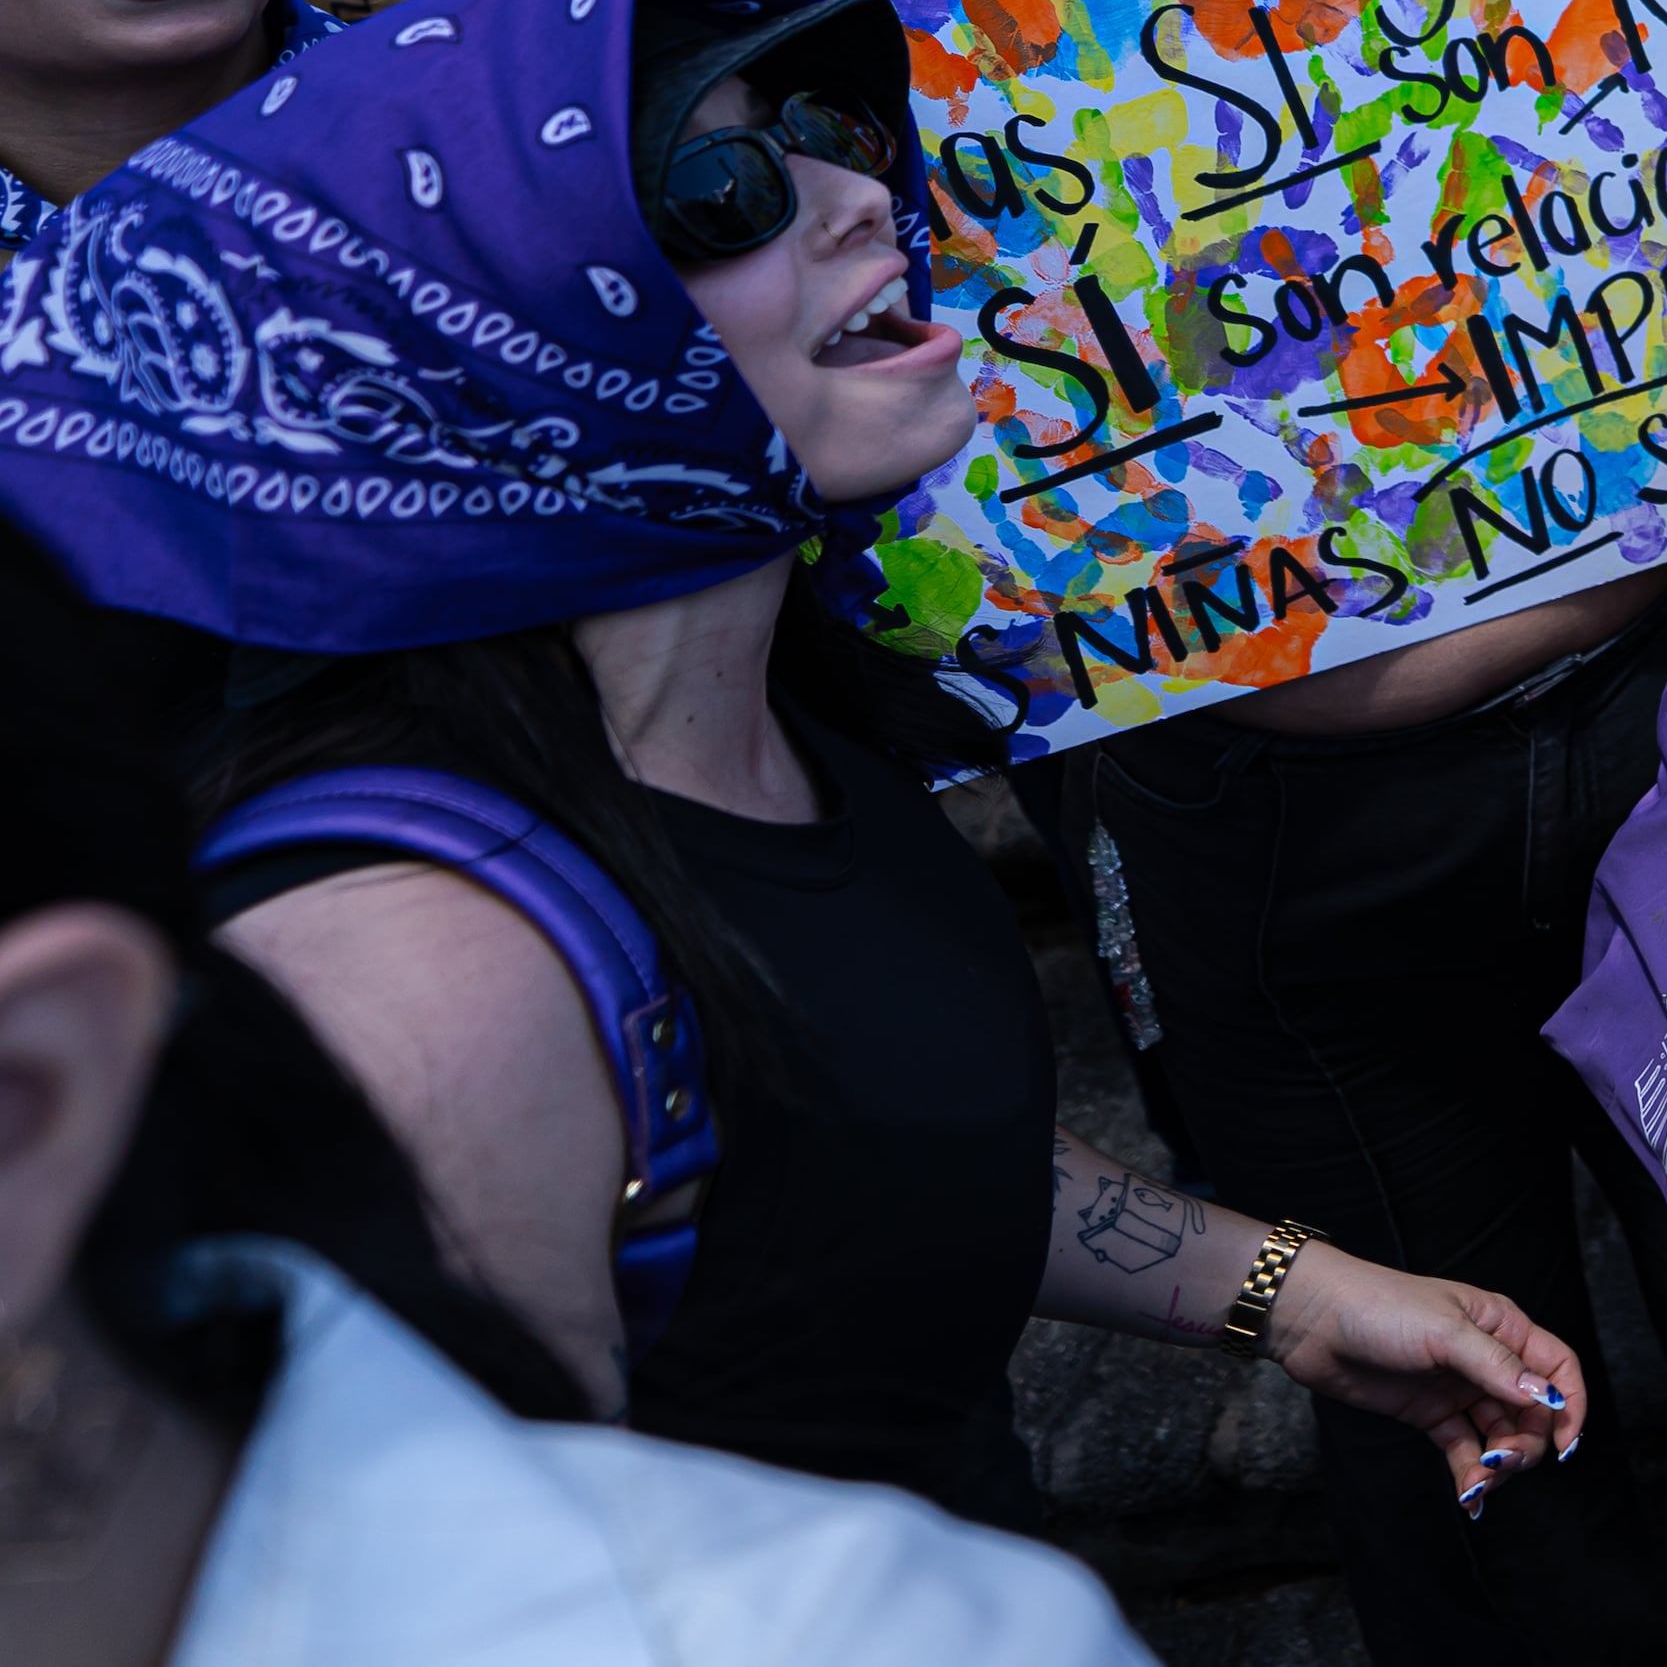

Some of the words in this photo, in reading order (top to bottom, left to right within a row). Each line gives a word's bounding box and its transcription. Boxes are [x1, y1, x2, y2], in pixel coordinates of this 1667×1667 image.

[1379, 24, 1558, 126] son
[1207, 253, 1396, 366] son
[1450, 446, 1599, 581] NO
